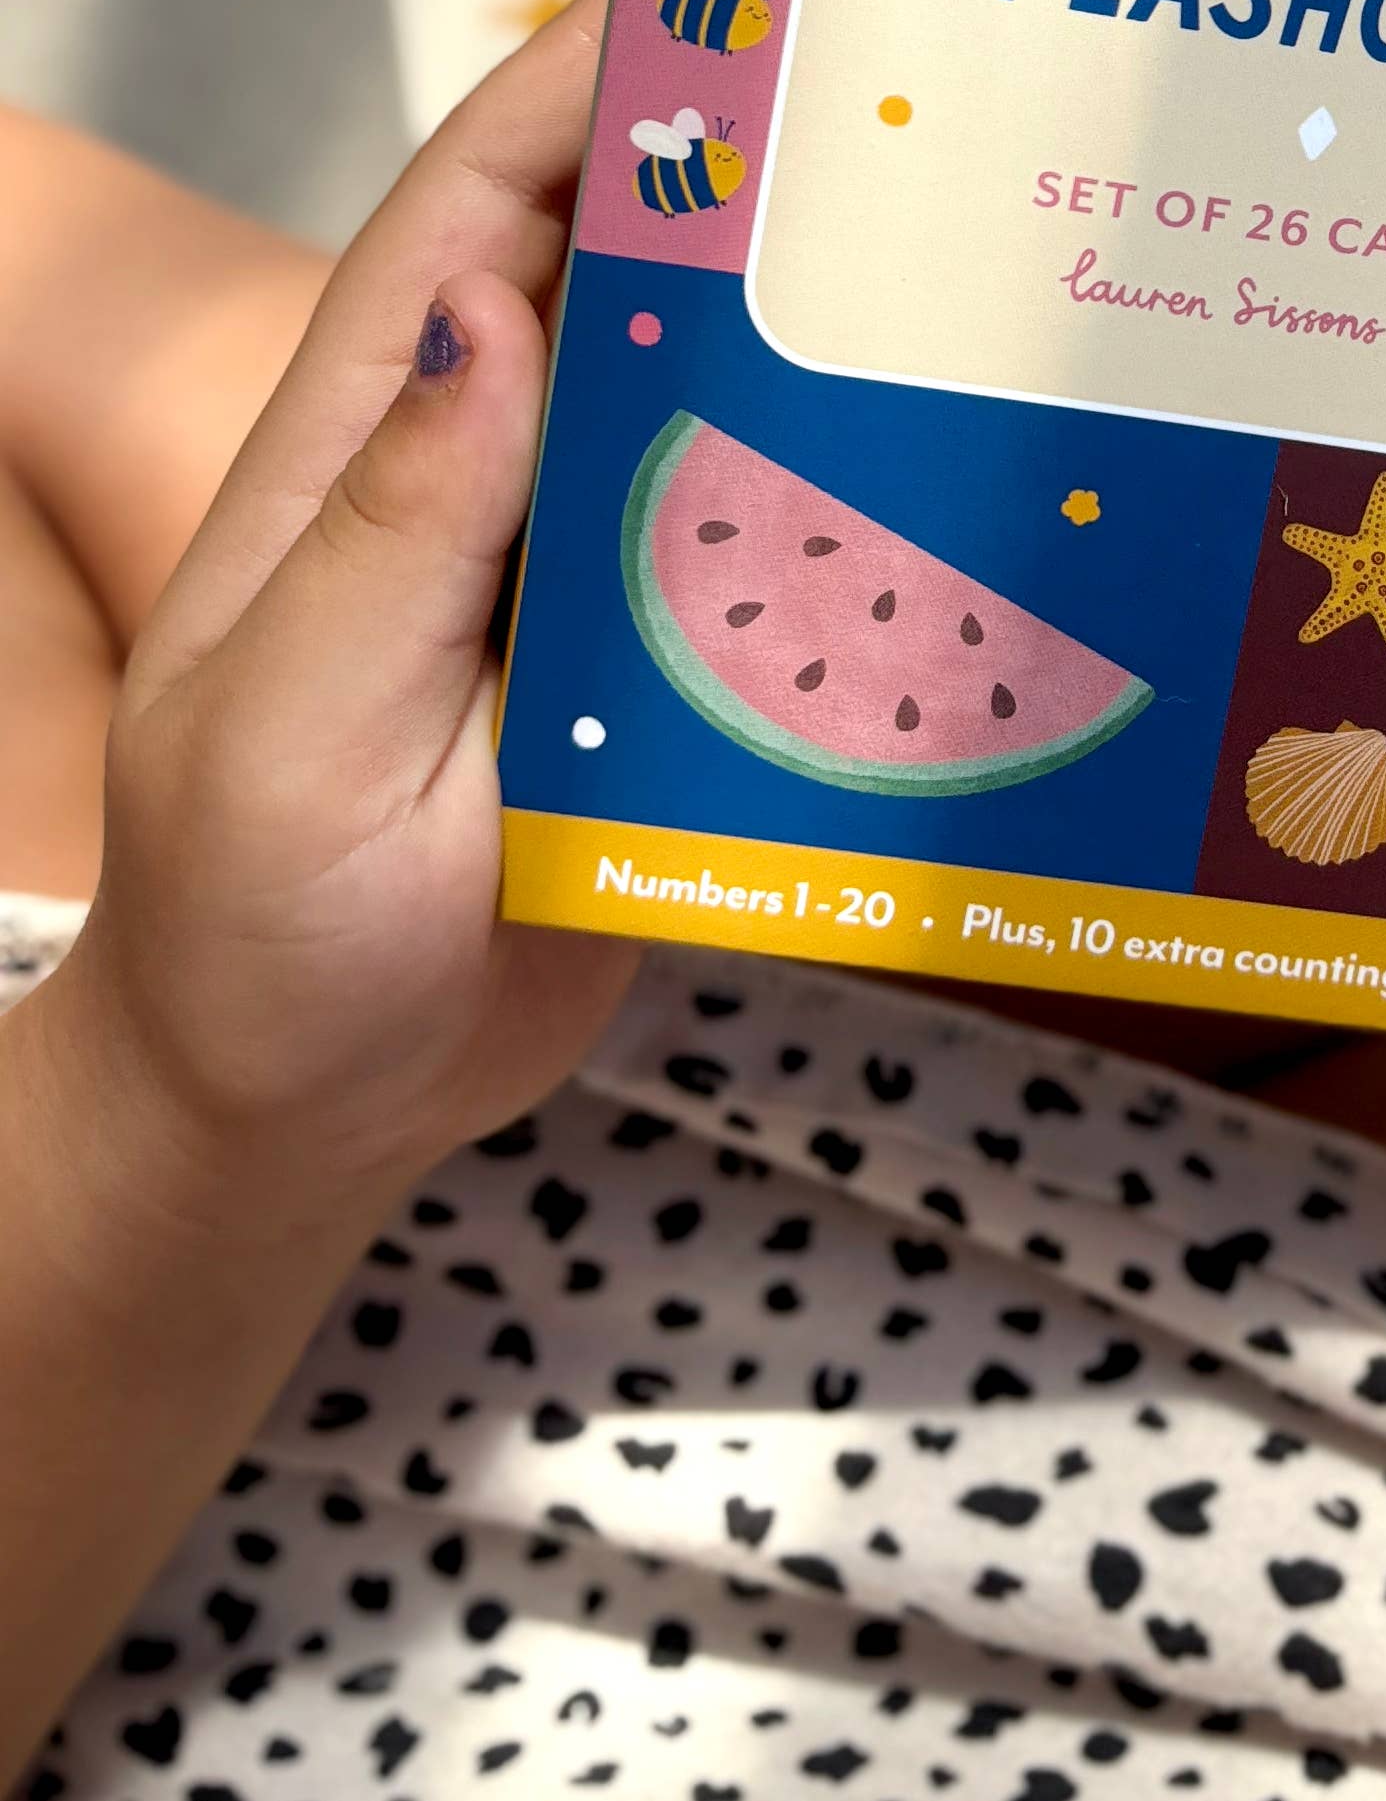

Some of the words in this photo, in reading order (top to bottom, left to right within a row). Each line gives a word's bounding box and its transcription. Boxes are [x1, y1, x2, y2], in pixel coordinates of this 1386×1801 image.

[1032, 170, 1138, 219] SET
[1155, 190, 1232, 233] OF
[1245, 203, 1310, 247] 26
[1233, 276, 1386, 345] Sissons
[595, 856, 783, 915] Numbers
[961, 903, 1056, 954] Plus,
[1069, 916, 1117, 956] 10
[1123, 936, 1225, 969] extra
